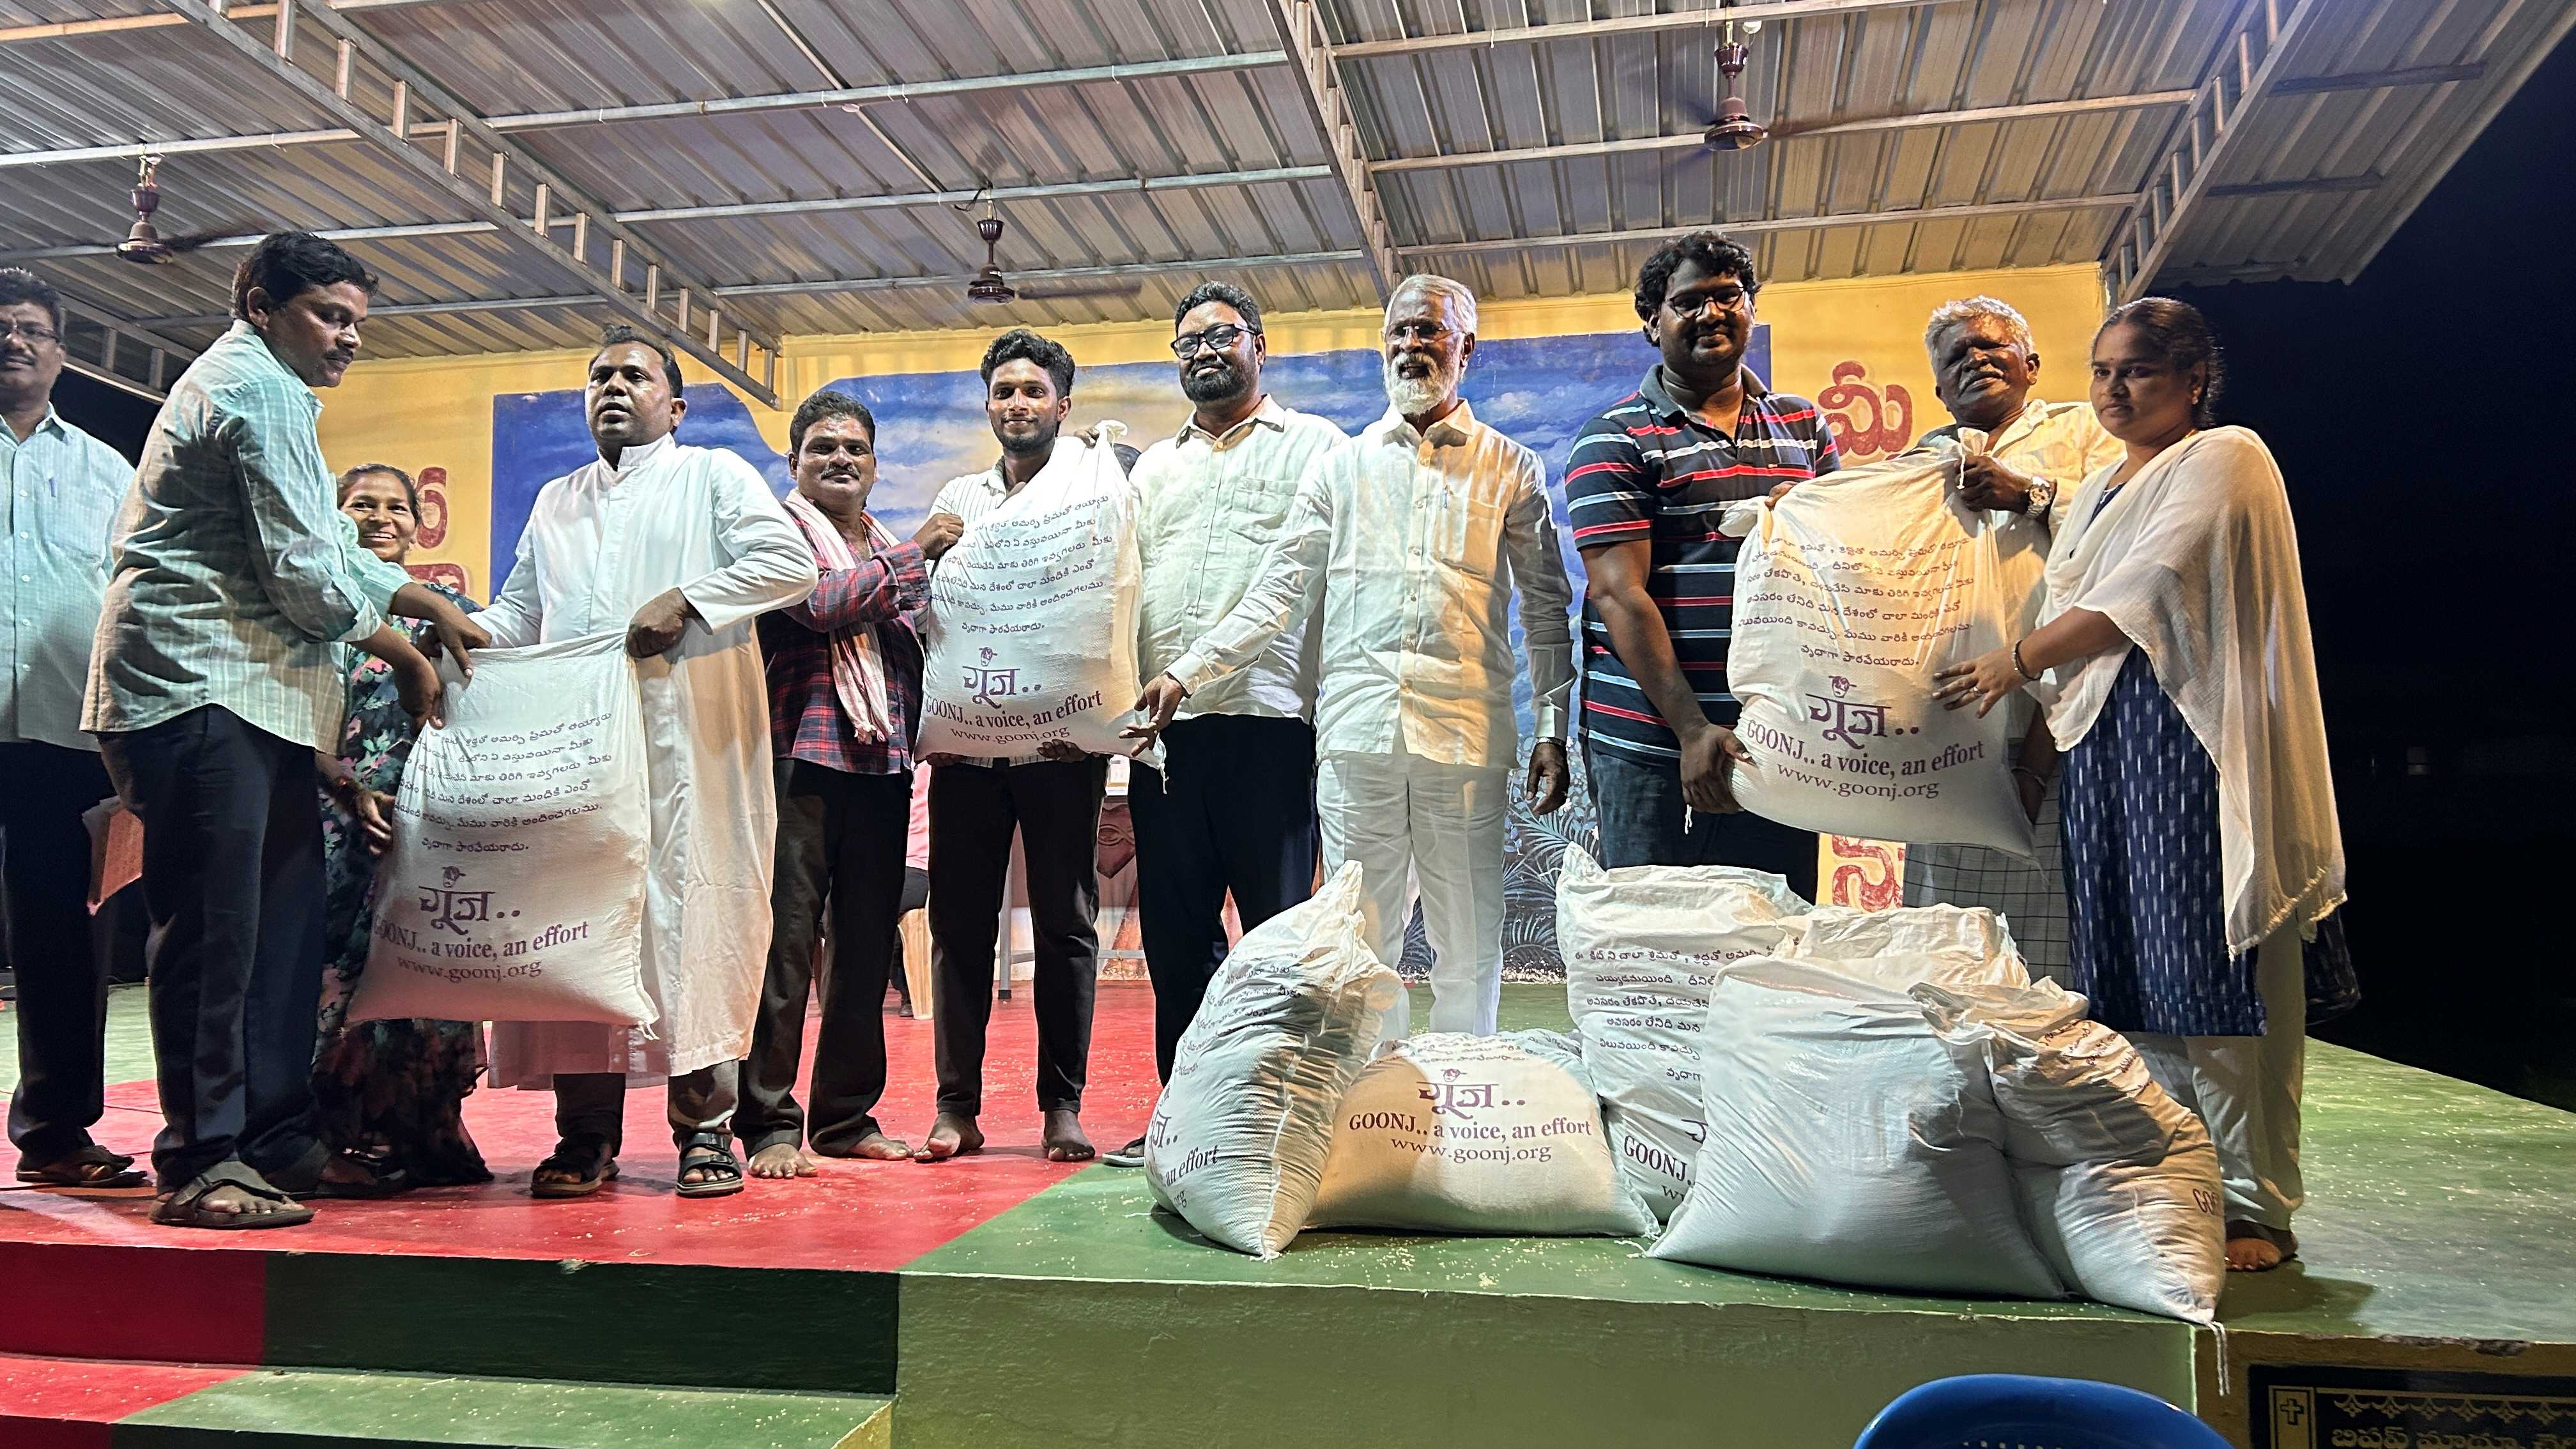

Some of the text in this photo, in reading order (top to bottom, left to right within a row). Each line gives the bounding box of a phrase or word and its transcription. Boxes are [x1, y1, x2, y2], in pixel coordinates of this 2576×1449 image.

[976, 716, 985, 727] a
[985, 710, 1031, 729] voice,
[1032, 711, 1054, 726] an
[1056, 690, 1103, 719] effort
[951, 725, 1070, 745] www.goonj.org
[1821, 754, 1831, 769] a
[1837, 753, 1896, 780] voice,
[1901, 758, 1926, 776] an
[1931, 740, 1984, 771] effort
[1777, 763, 1940, 802] www.goonj.org
[431, 940, 440, 956] a
[445, 937, 498, 960] voice,
[503, 939, 527, 957] an
[533, 921, 589, 951] effort
[397, 957, 543, 984] www.goonj.org
[1434, 1125, 1445, 1137] a
[1450, 1122, 1506, 1142] voice,
[1512, 1124, 1536, 1139] an
[1541, 1117, 1591, 1136] effort
[1179, 1145, 1218, 1179] effort
[1392, 1139, 1552, 1165] www.goonj.org
